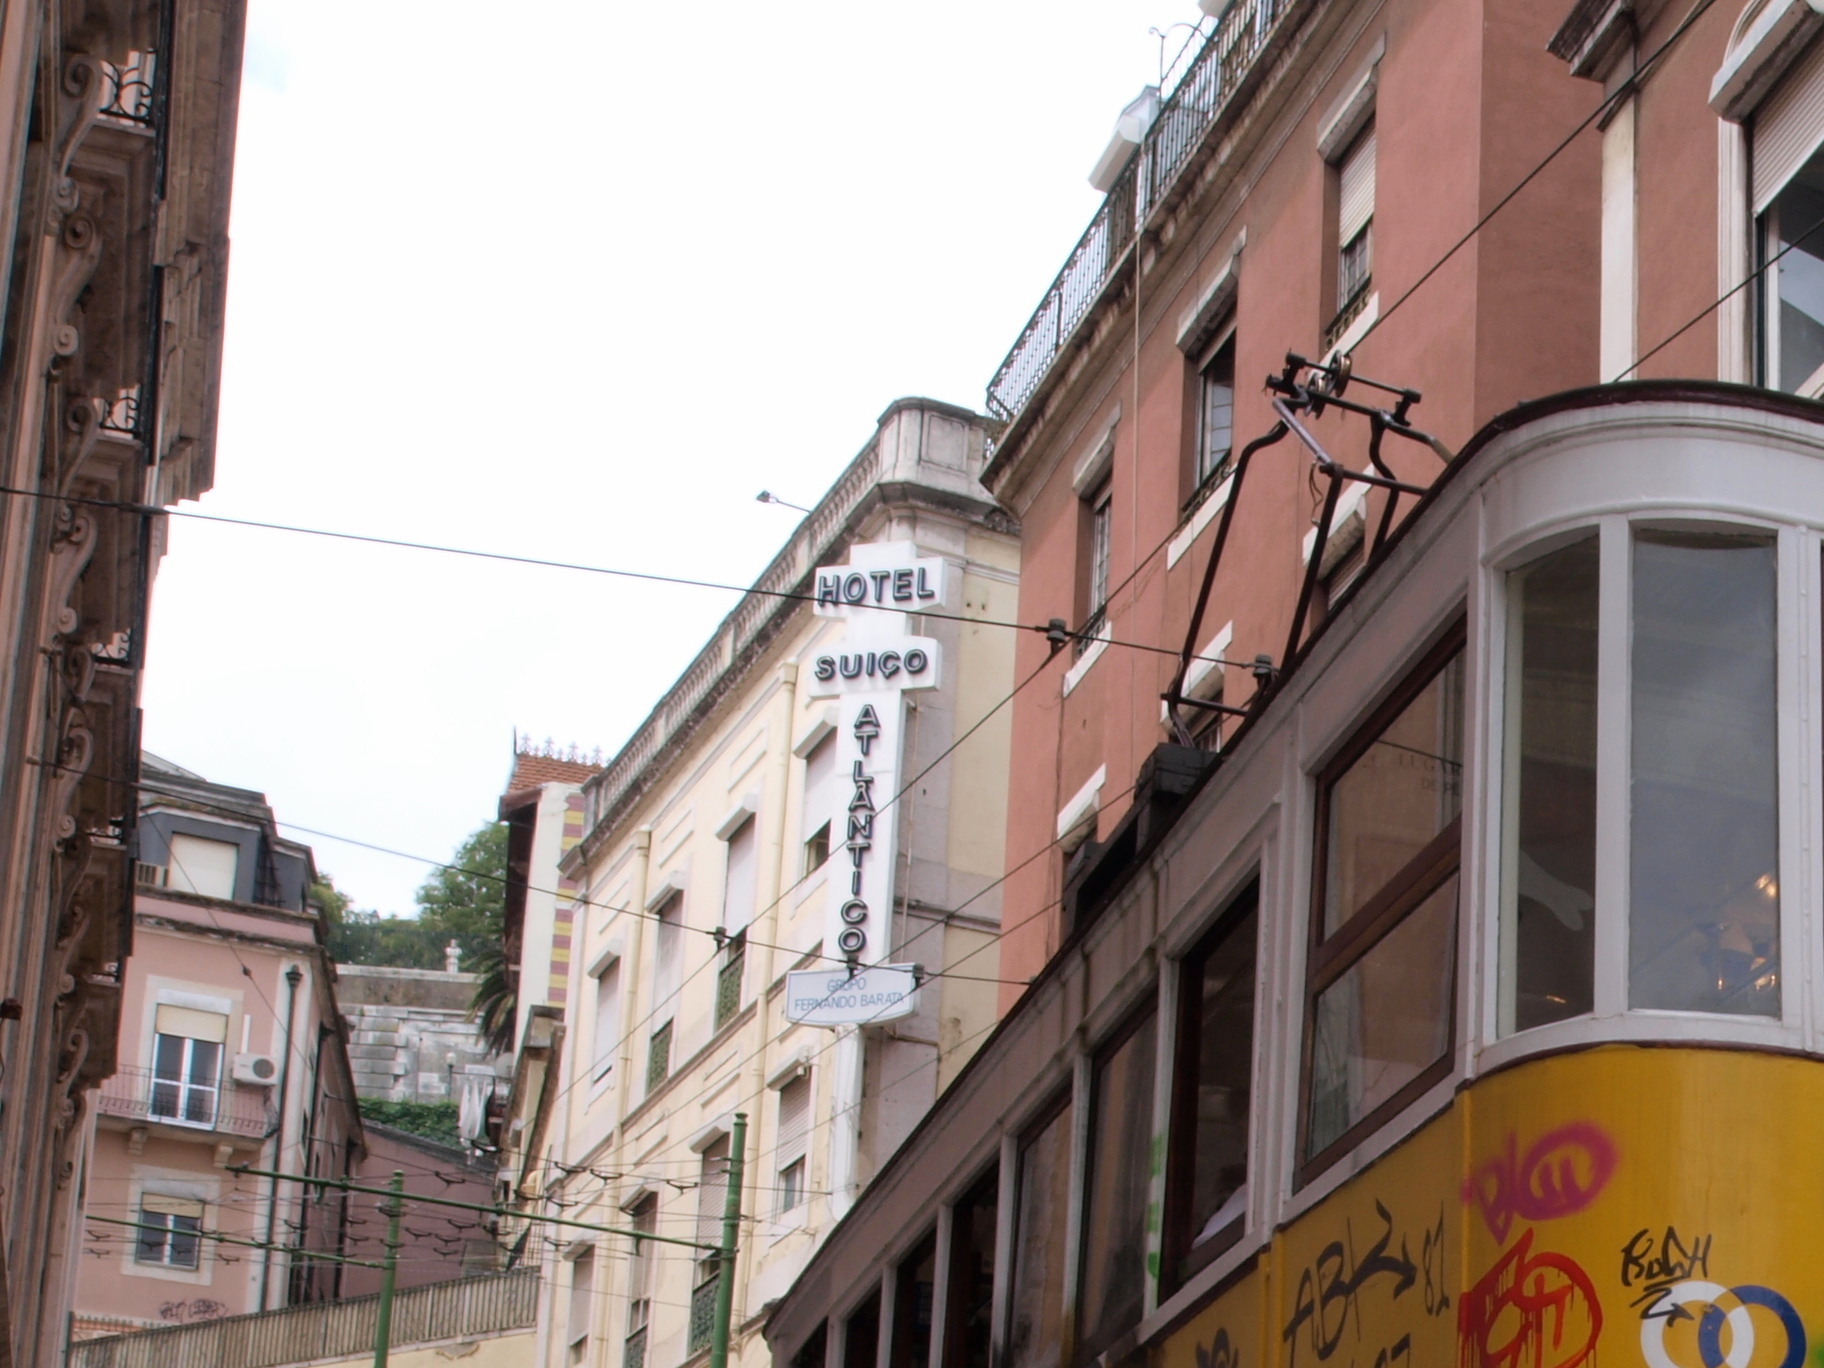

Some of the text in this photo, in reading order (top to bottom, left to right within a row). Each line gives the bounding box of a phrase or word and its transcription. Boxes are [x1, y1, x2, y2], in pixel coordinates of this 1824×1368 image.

[818, 566, 935, 606] HOTEL
[814, 647, 928, 681] SUIÇO
[837, 703, 882, 955] ATLÂNTICO
[794, 992, 904, 1011] FERNANDO BARATA
[827, 977, 866, 994] GRUPO
